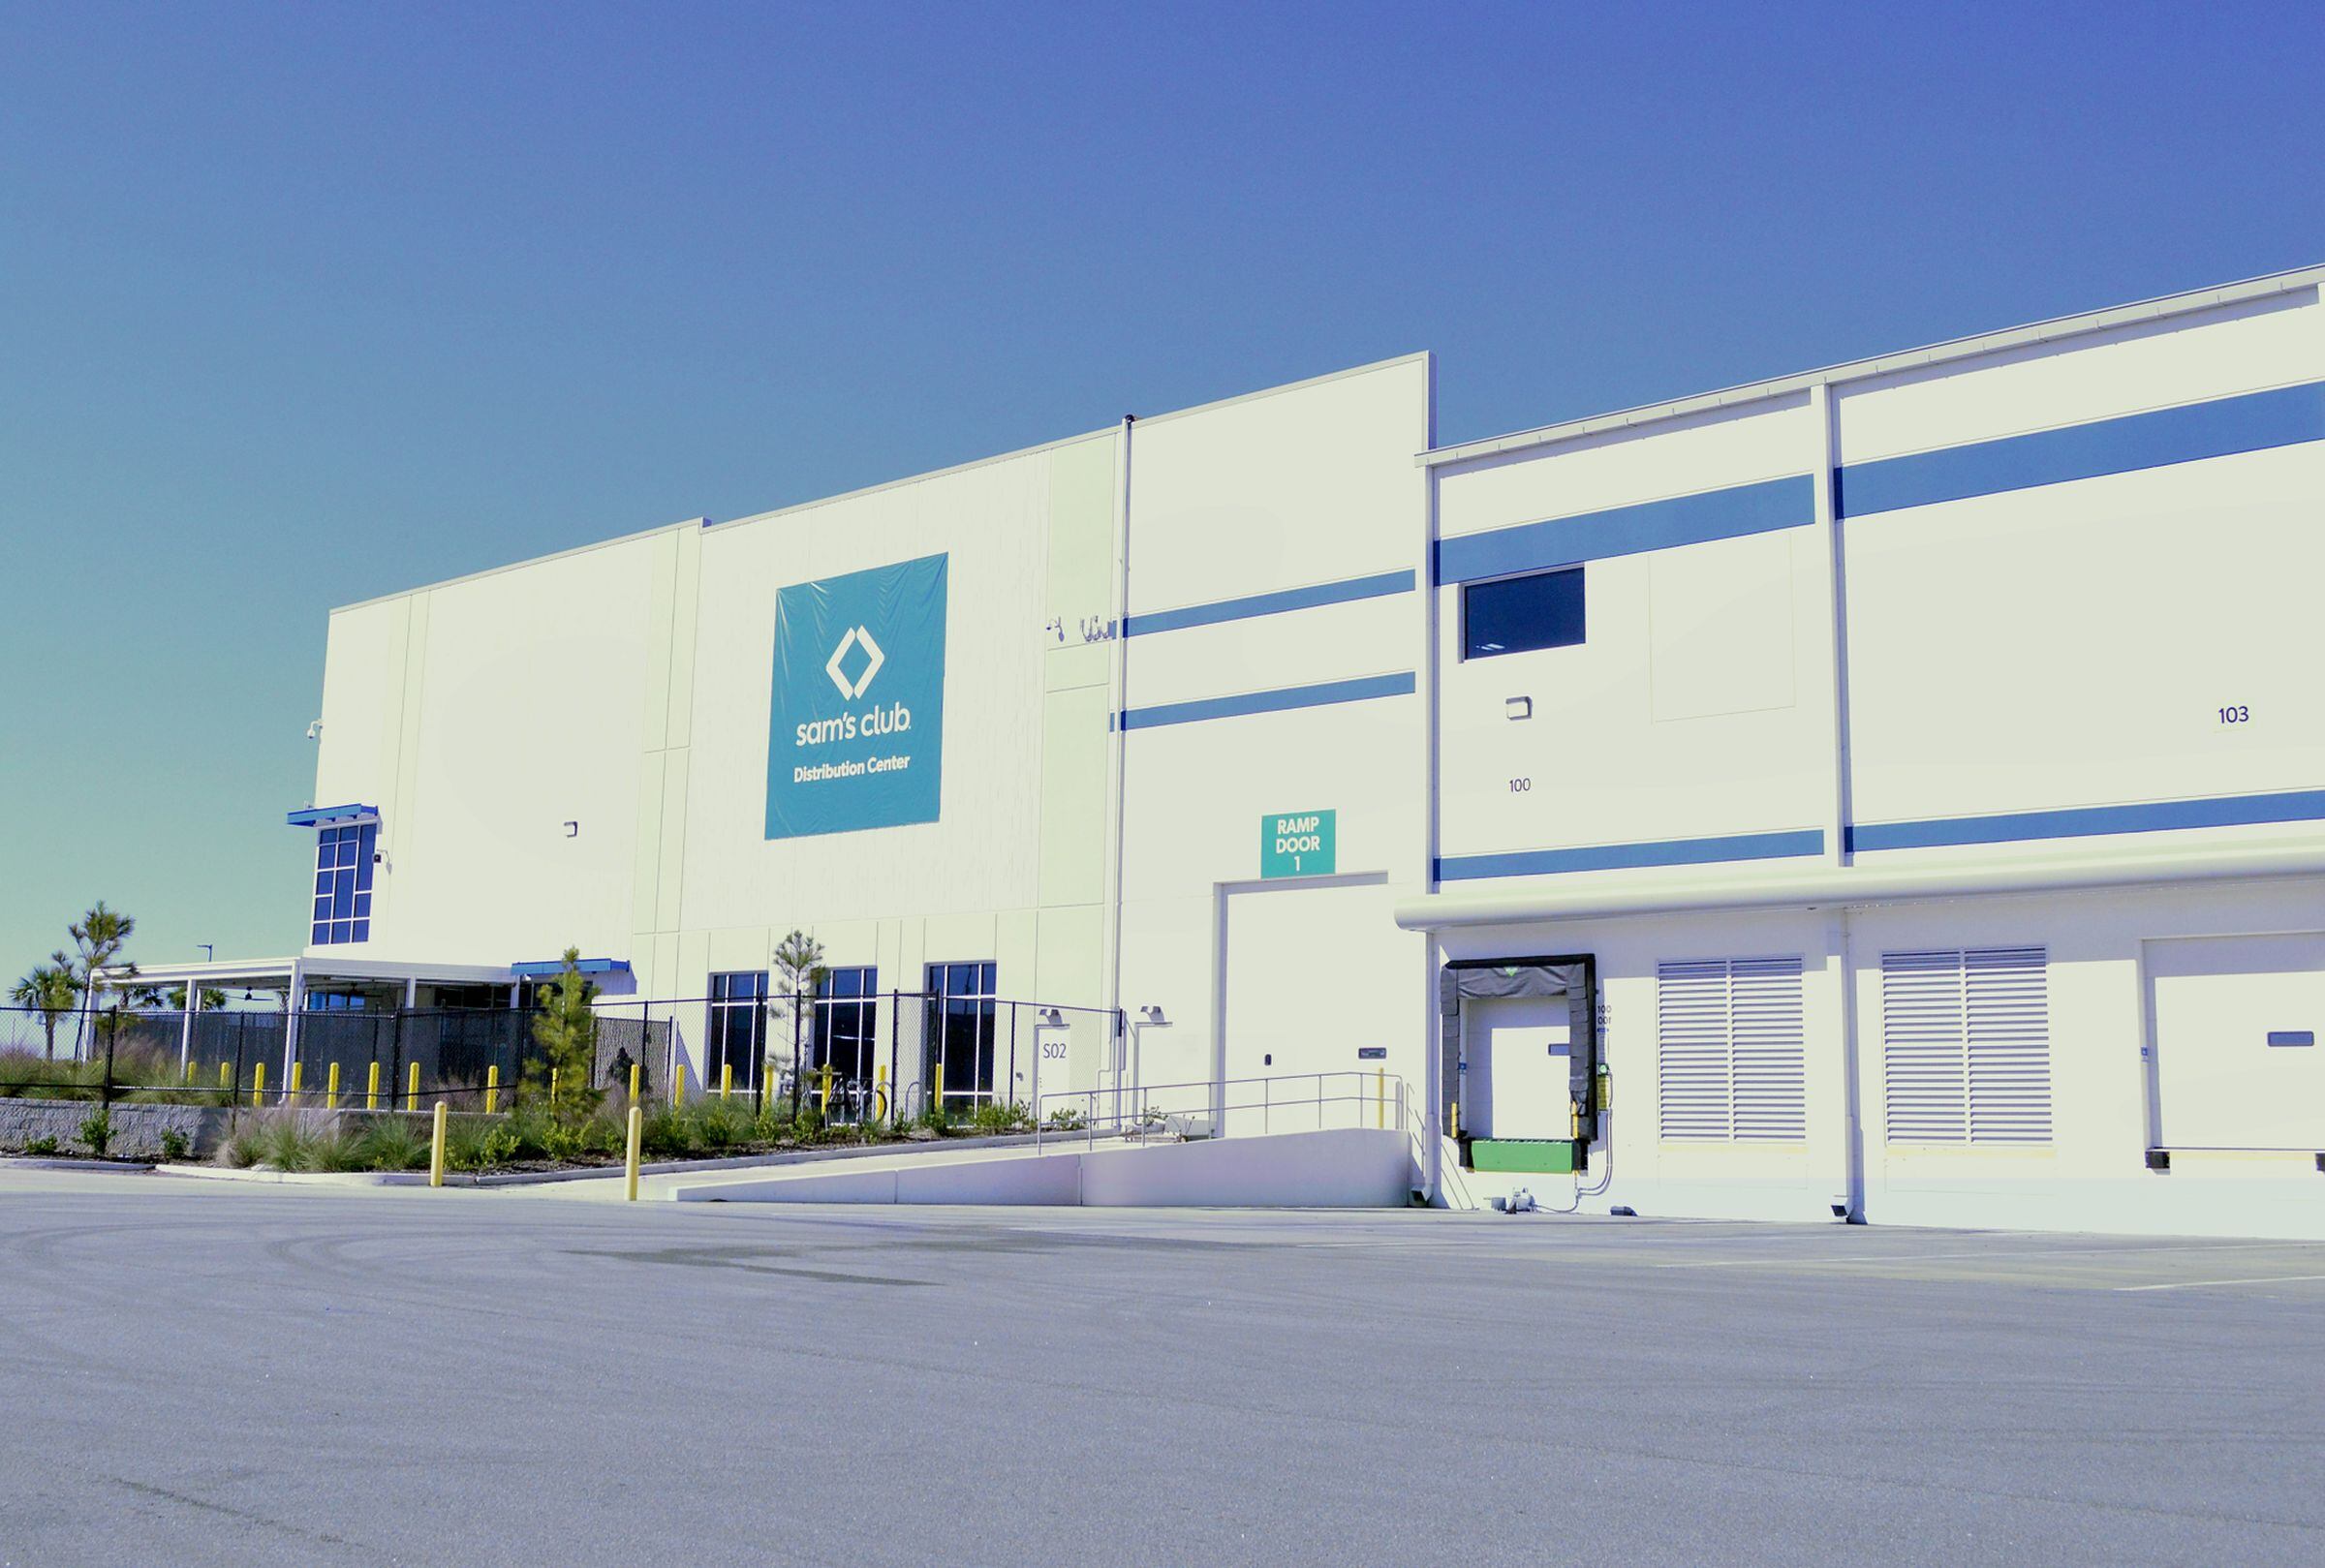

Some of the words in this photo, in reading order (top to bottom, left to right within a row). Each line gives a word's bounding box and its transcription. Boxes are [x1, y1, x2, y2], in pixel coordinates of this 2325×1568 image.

[2218, 705, 2249, 723] 103
[795, 711, 856, 747] sam's
[860, 701, 911, 736] club
[793, 760, 865, 783] Distribution
[867, 755, 911, 774] Center
[1509, 778, 1531, 792] 100
[1277, 816, 1319, 834] RAMP
[1276, 835, 1320, 853] DOOR
[1293, 855, 1300, 872] 1
[1597, 1004, 1612, 1014] 100
